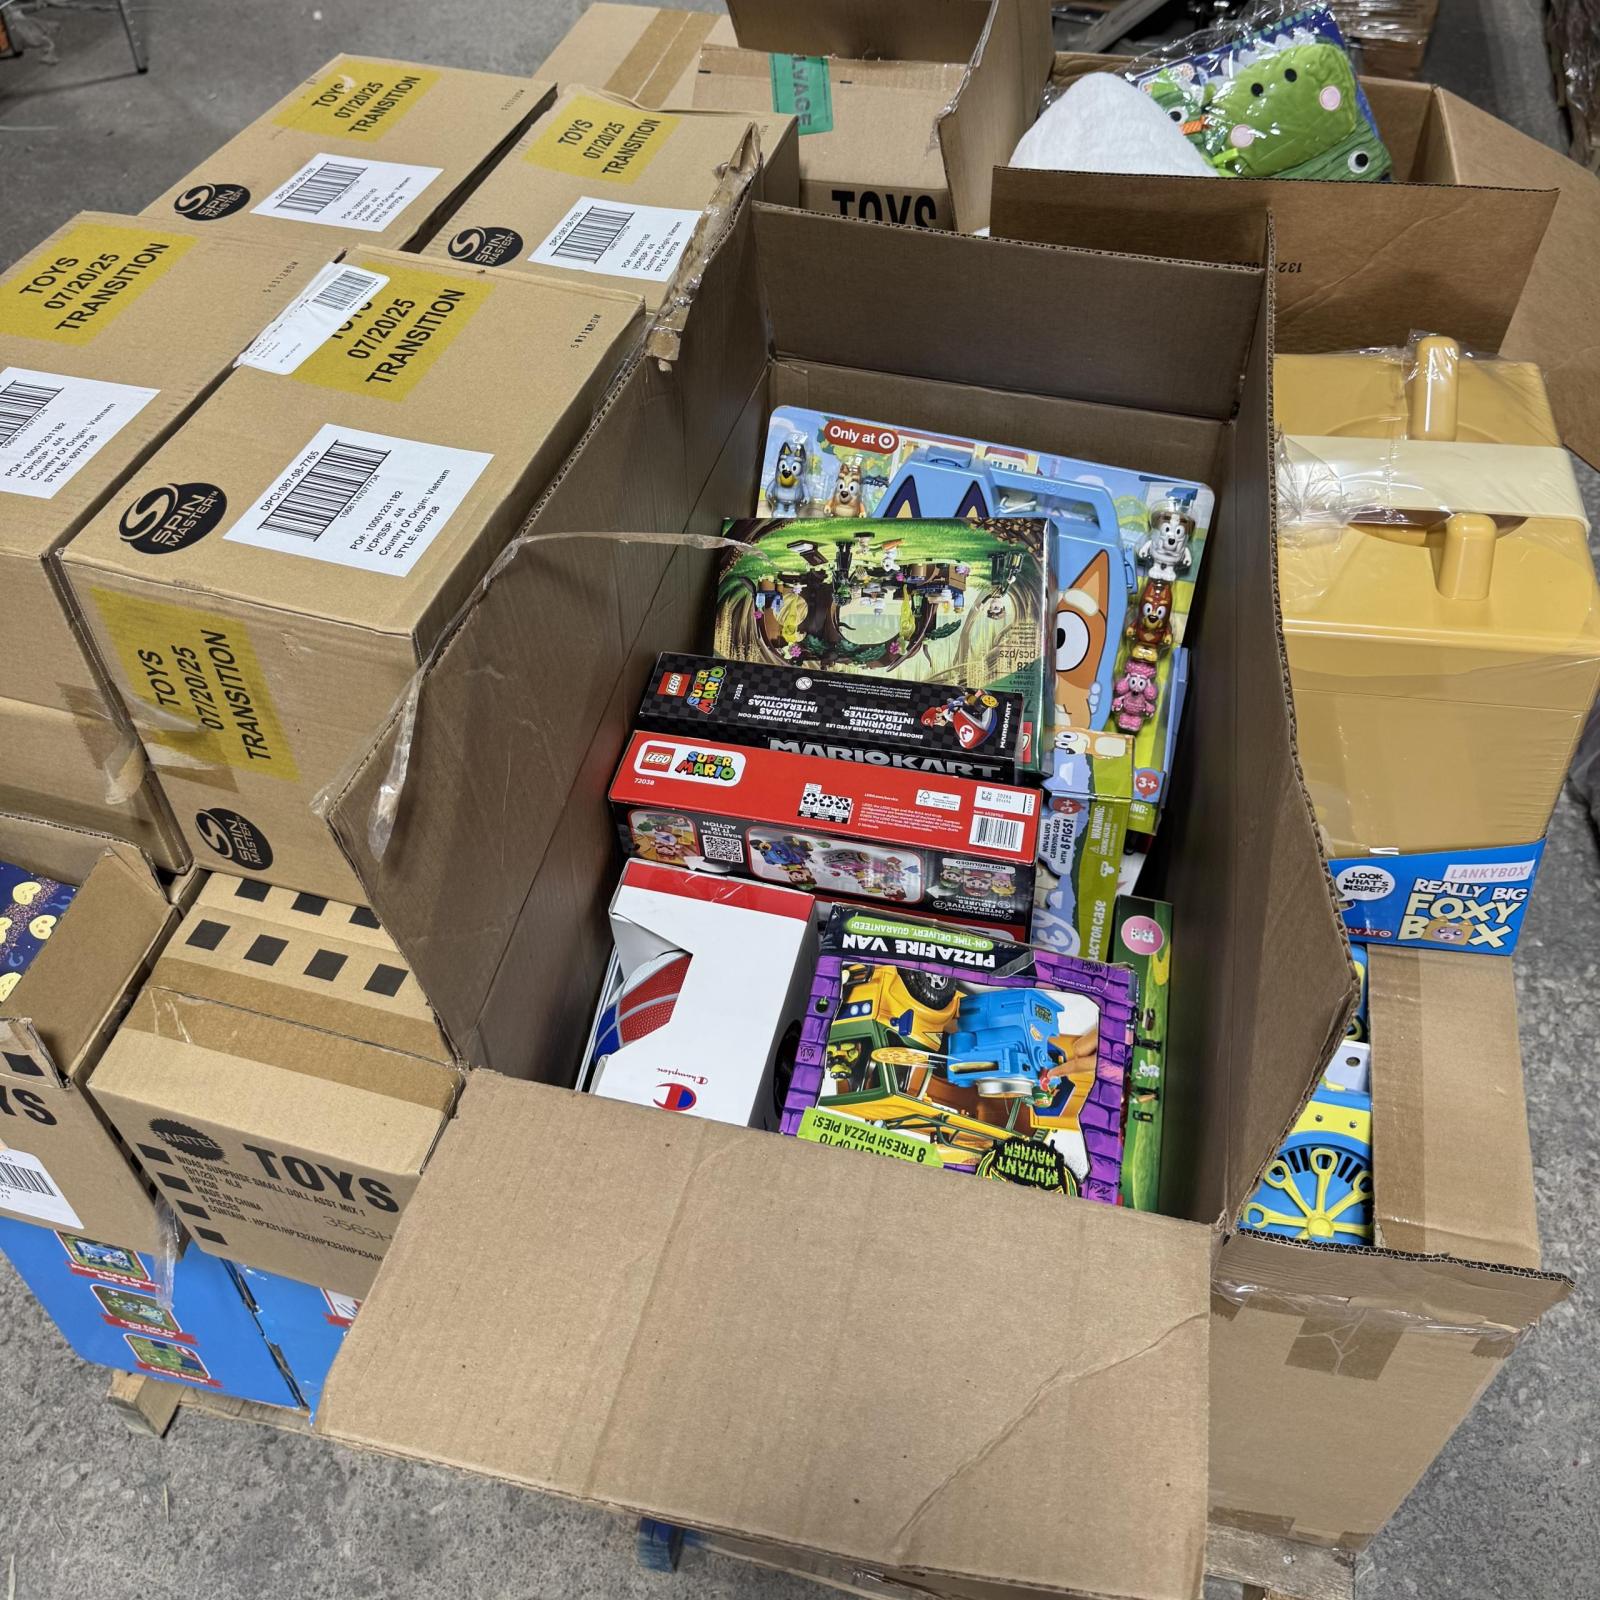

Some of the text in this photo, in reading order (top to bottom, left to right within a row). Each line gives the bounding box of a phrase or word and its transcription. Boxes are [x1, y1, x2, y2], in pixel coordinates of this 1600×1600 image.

[334, 82, 384, 119] 07/20/25
[348, 76, 421, 134] TRANSITION
[557, 119, 593, 147] TOYS
[582, 121, 625, 160] 07/20/25
[601, 118, 661, 175] TRANSITION
[198, 190, 232, 215] SPIN
[474, 234, 507, 263] SPIN
[18, 256, 79, 295] TOYS
[43, 253, 120, 310] 07/20/25
[54, 242, 170, 330] TRANSITION
[346, 298, 416, 360] 07/20/25
[365, 288, 466, 384] TRANSITION
[30, 402, 117, 482] Country Of Origin: Vietnam
[830, 425, 875, 445] Only at
[43, 456, 73, 484] STYLE:
[151, 494, 207, 544] SPIN
[378, 468, 451, 556] Country Of Origin: Vietnam
[393, 529, 420, 559] STYLE:
[1000, 649, 1036, 661] pcs/pzs
[1017, 661, 1034, 672] 228
[138, 648, 181, 706] TOYS
[170, 644, 225, 731] 07/20/25
[666, 672, 682, 695] LEGO
[687, 670, 709, 705] SUPER
[200, 628, 272, 760] TRANSITION
[698, 667, 724, 713] MARIO
[748, 698, 818, 713] INTERACTIVAS
[759, 707, 802, 719] FIGURAS
[842, 708, 914, 725] INTERACTIVES,
[792, 719, 821, 727] AUMENTA
[849, 718, 902, 731] FIGURINES
[1000, 702, 1012, 749] MARIOKART
[899, 732, 924, 740] ENCORE
[645, 752, 672, 764] LEGO
[675, 760, 735, 781] MARIO
[687, 751, 733, 766] SUPER
[768, 738, 1001, 778] MARIOKART
[634, 777, 655, 785] 72038
[1138, 776, 1157, 789] 3+
[1060, 800, 1073, 812] 3+
[702, 821, 736, 830] ACTION
[1061, 818, 1074, 844] FIGS!
[226, 818, 253, 861] SPIN
[1344, 878, 1389, 888] WHAT'S
[1352, 871, 1383, 880] LOOK
[1450, 865, 1528, 879] LANKYBOX
[1413, 878, 1528, 902] REALLY BIG
[947, 901, 1004, 914] INTERACTIVE
[1405, 892, 1522, 924] FOXY
[851, 921, 909, 935] GUARANTEED!
[912, 929, 951, 941] DELIVERY,
[842, 933, 995, 968] PIZZAFIRE VAN
[953, 935, 988, 949] ON-TIME
[656, 1066, 709, 1085] Champion
[812, 1115, 842, 1133] PIES!
[844, 1124, 877, 1144] PIZZA
[155, 1131, 222, 1149] MATTEL
[878, 1135, 915, 1157] FRESH
[916, 1147, 926, 1162] 8
[1003, 1142, 1057, 1169] MAYHEM
[242, 1143, 399, 1213] TOYS
[997, 1157, 1060, 1188] MUTANT
[195, 1185, 263, 1211] MADE IN CHINA
[209, 1197, 241, 1212] PIECES
[252, 1178, 285, 1194] SMALL
[285, 1187, 313, 1201] DOLL
[313, 1196, 337, 1209] ASST
[339, 1203, 359, 1215] MIX
